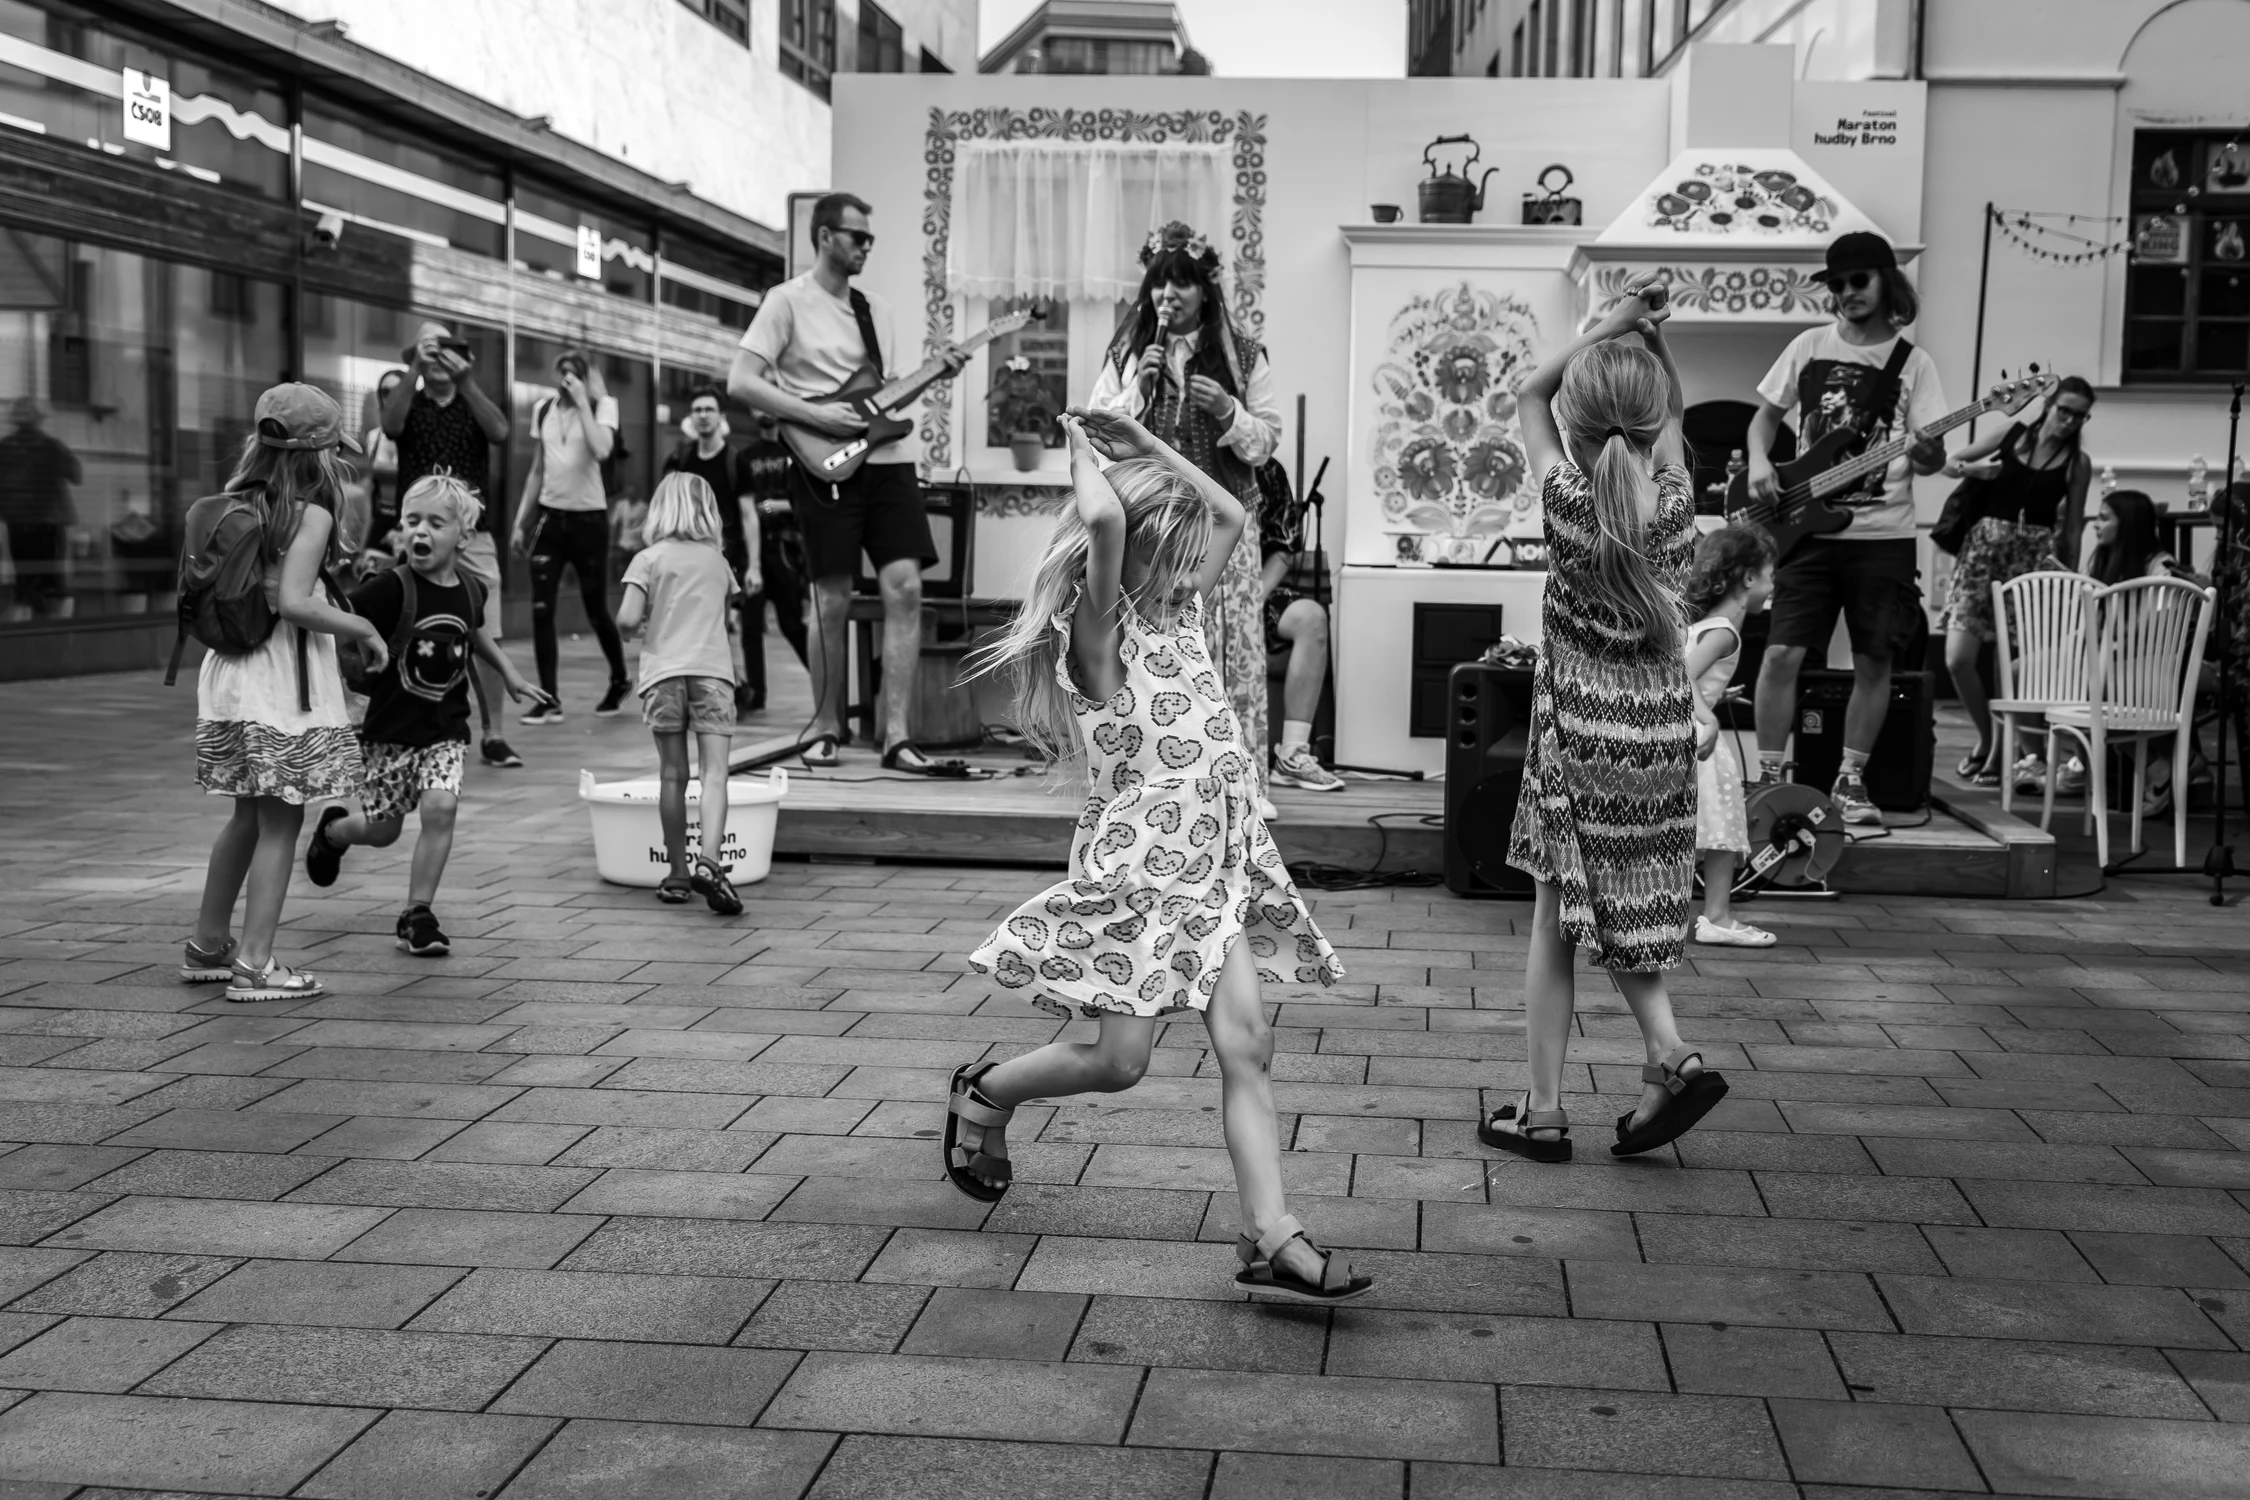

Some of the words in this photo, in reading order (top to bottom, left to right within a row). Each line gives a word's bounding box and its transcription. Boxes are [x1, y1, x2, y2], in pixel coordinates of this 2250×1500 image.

[1837, 118, 1897, 130] Maraton
[1814, 132, 1857, 148] hudby
[1861, 132, 1896, 145] Brno
